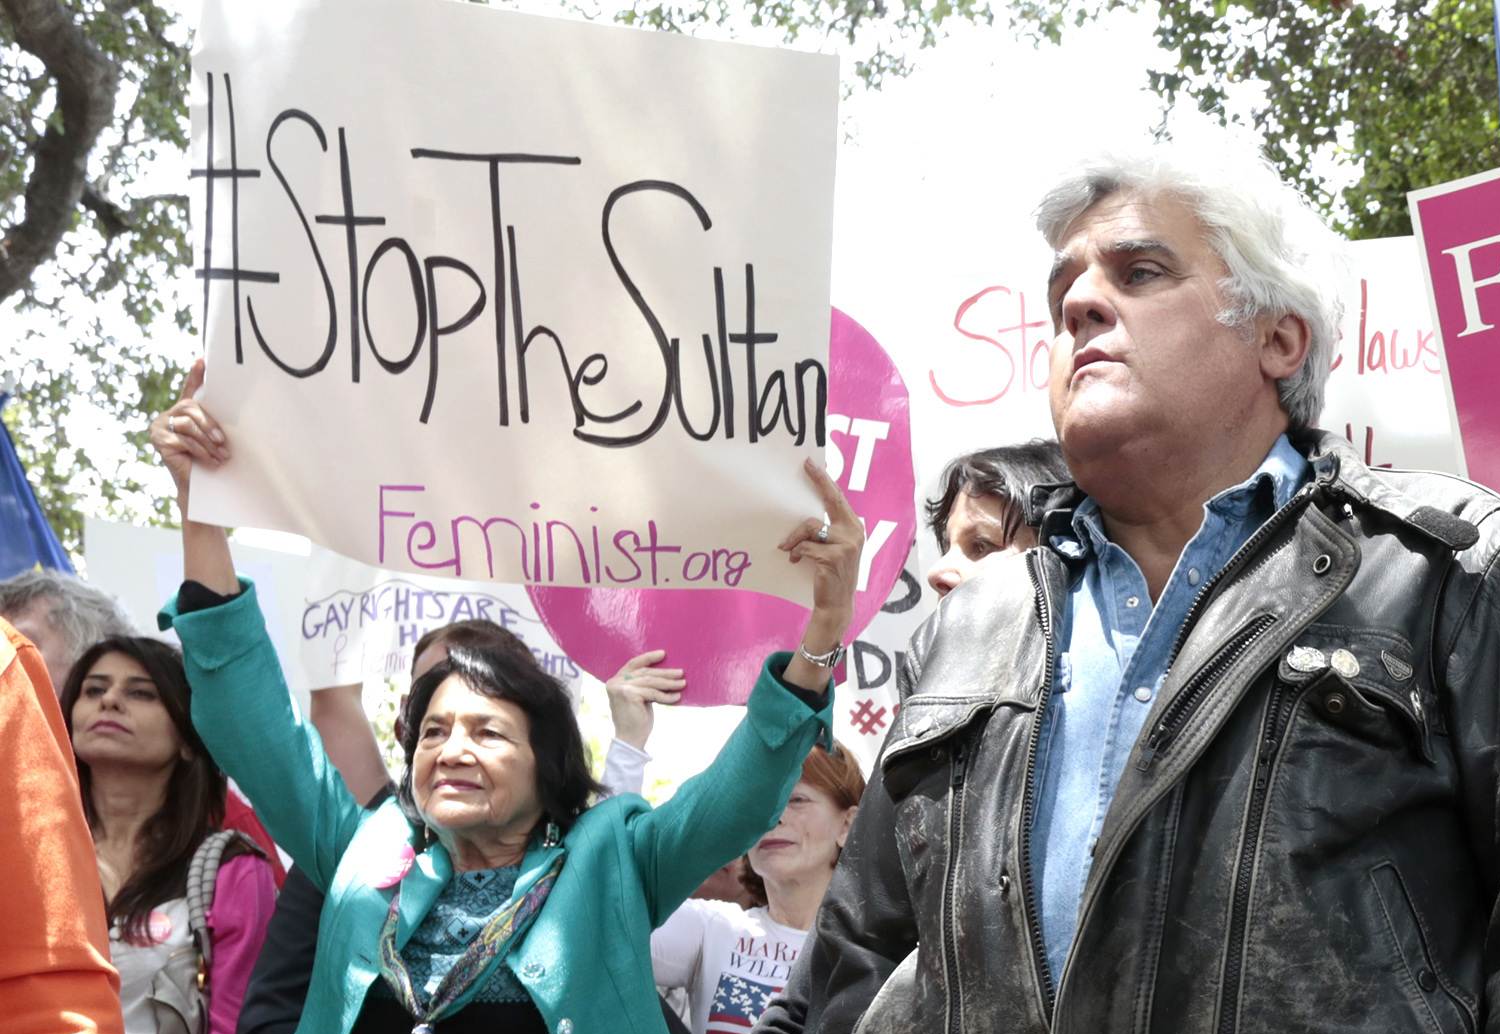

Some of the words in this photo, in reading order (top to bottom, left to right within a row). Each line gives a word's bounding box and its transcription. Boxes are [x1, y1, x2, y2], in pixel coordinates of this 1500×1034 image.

[190, 72, 826, 447] #StopTheSultan
[378, 484, 752, 586] Feminist.org
[301, 597, 354, 641] GAY
[449, 595, 520, 629] ARE
